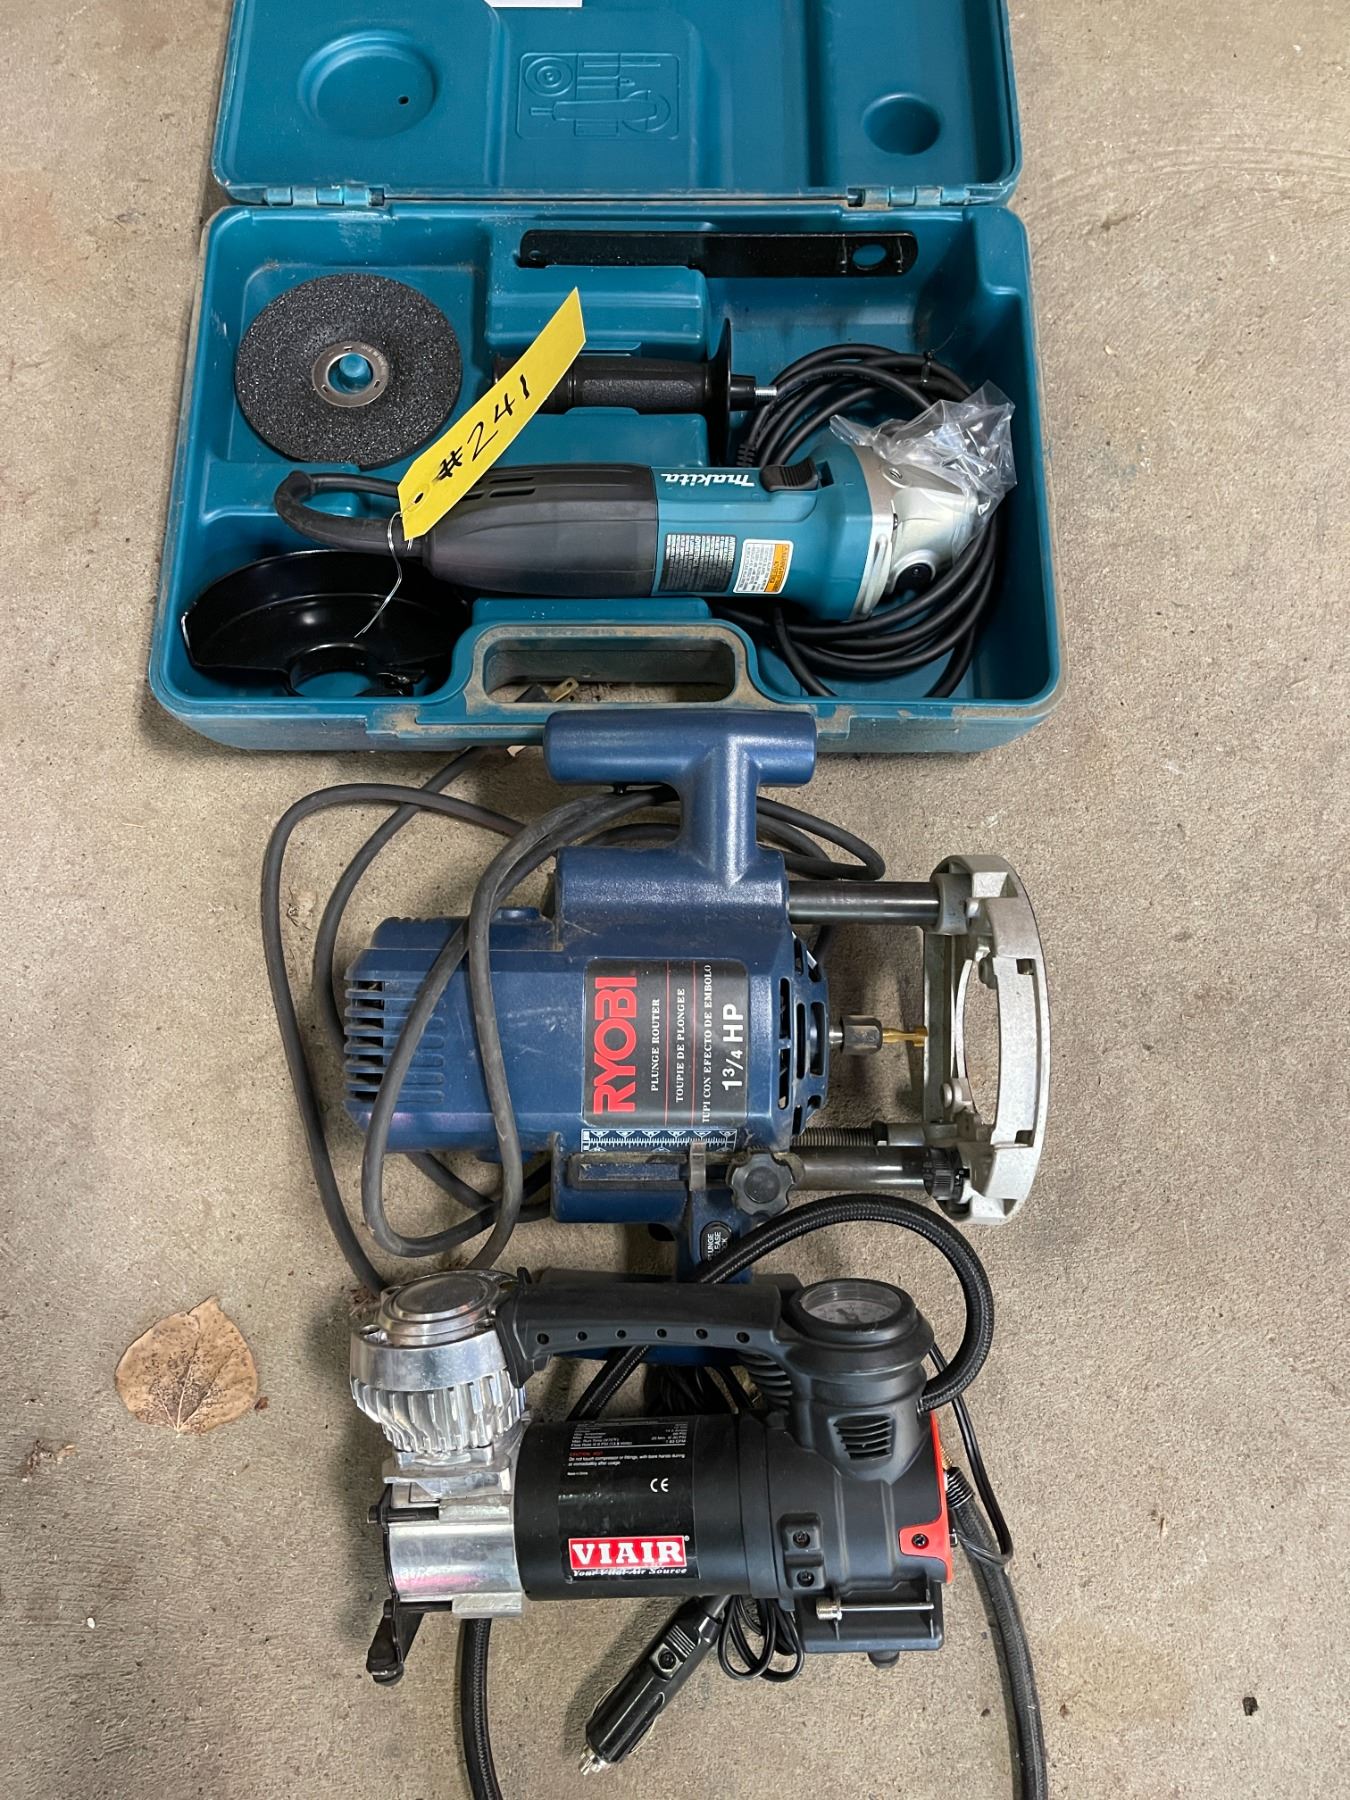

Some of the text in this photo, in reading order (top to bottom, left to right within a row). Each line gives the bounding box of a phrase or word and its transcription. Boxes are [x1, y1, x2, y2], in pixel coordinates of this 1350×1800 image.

[432, 374, 530, 482] #241
[593, 976, 637, 1115] RYOBI
[651, 998, 660, 1091] PLUNGE ROUTER
[675, 987, 686, 1103] TOUPIE DE PLONGEE
[702, 964, 713, 1123] TUPI CON EFECTO DE EMBOLO
[722, 1002, 743, 1043] HP
[571, 1540, 684, 1565] VIAIR
[649, 1567, 687, 1575] Source
